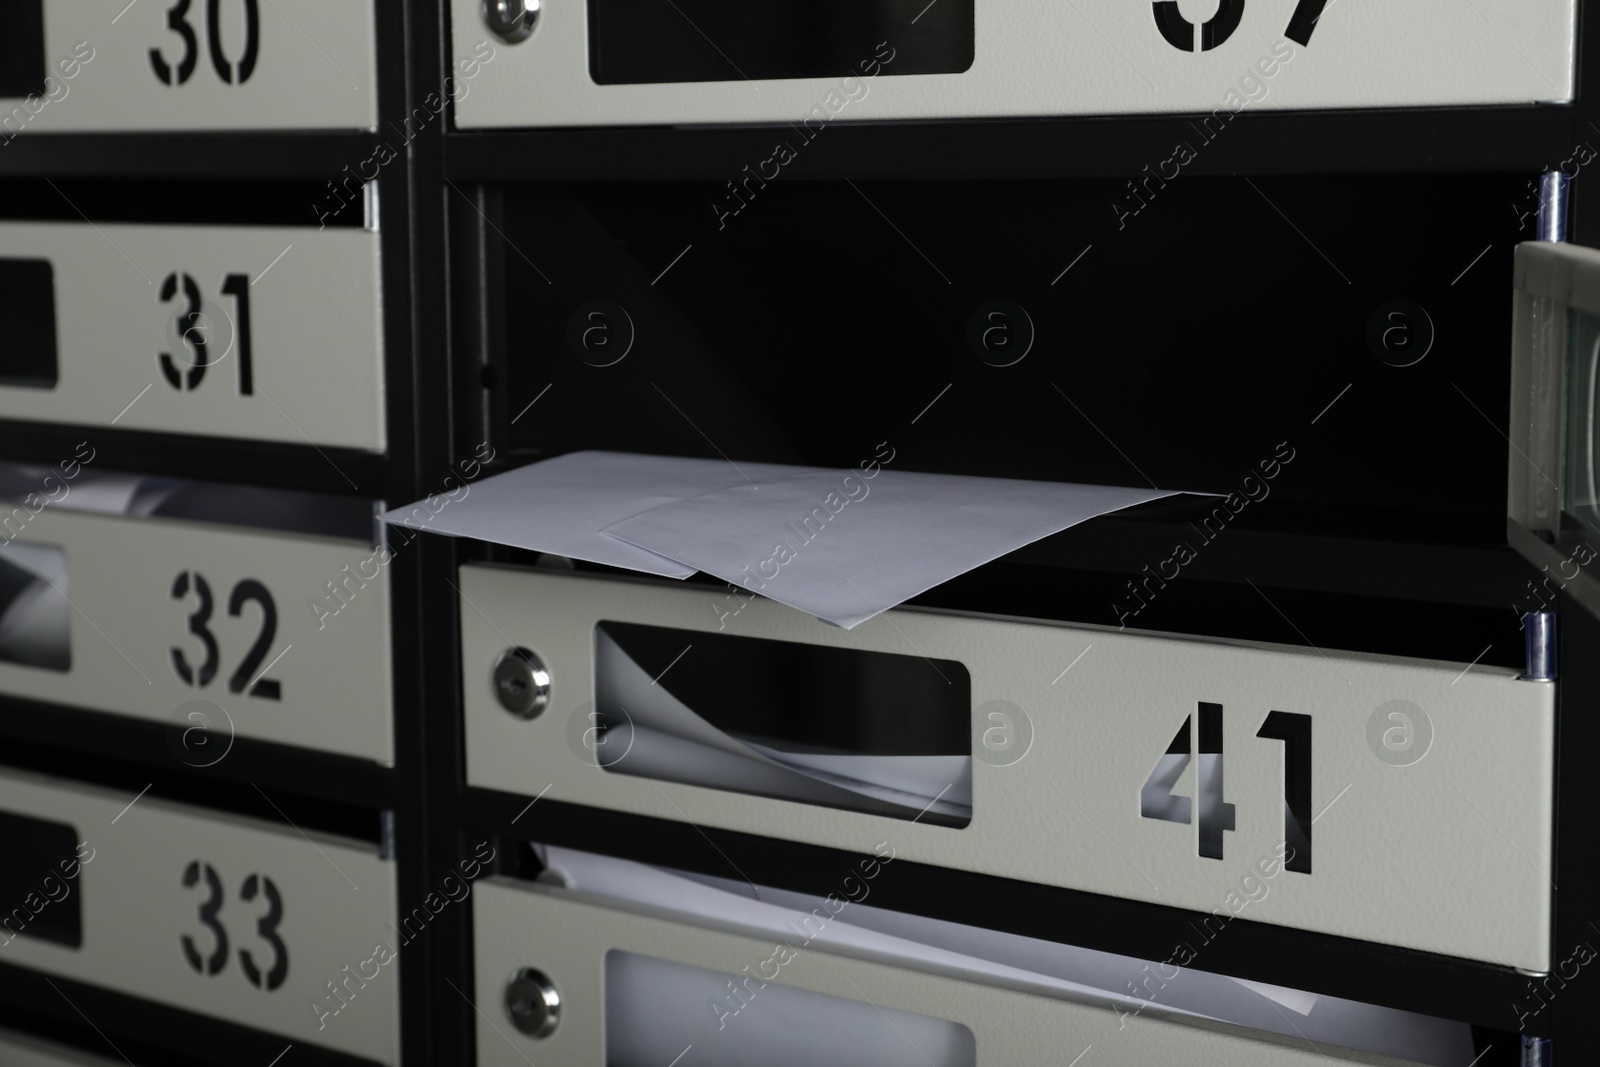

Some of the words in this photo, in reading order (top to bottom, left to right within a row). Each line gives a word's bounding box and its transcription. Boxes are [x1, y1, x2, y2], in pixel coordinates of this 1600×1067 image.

[148, 0, 260, 86] 30
[159, 271, 254, 396] 31
[170, 569, 282, 701] 32
[1140, 701, 1312, 875] 41
[180, 859, 290, 992] 33
